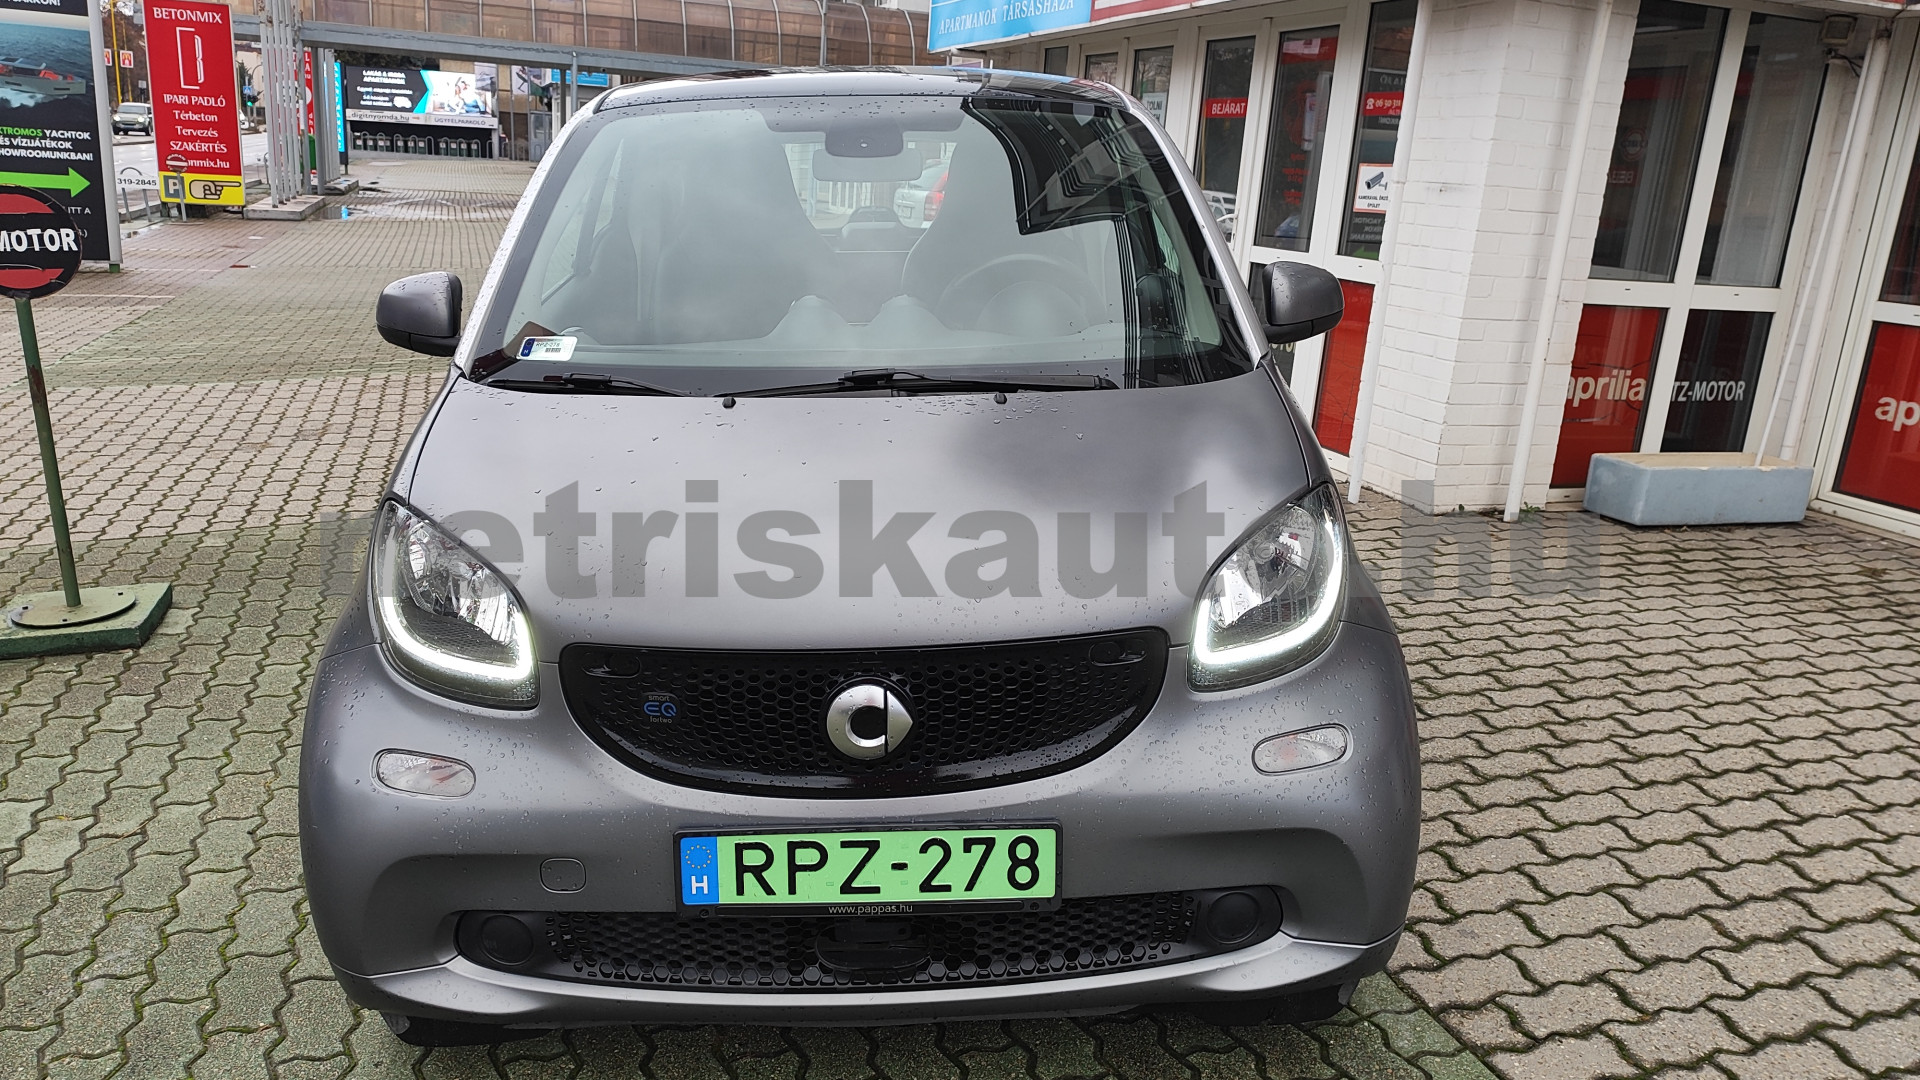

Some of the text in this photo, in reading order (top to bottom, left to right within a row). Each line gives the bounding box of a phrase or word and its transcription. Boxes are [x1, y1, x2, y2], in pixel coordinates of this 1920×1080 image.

[152, 7, 223, 24] BETONMIX
[938, 8, 998, 35] APARTMANOK
[163, 94, 226, 107] IPARI PADLÓ
[1211, 100, 1246, 115] BEJÁRAT
[173, 110, 218, 122] Térbeton
[44, 129, 91, 140] YACHTOK
[175, 125, 219, 138] Tervezés
[11, 137, 73, 149] VÍZIJÁTÉKOK
[170, 140, 228, 153] SZAKÉRTÉS
[117, 178, 157, 186] 319-2845
[168, 178, 179, 194] P
[67, 207, 91, 215] ITT A
[643, 701, 677, 717] EQ
[733, 834, 1041, 897] RPZ-278
[690, 875, 709, 895] H
[828, 903, 913, 915] www.pappas.hu
